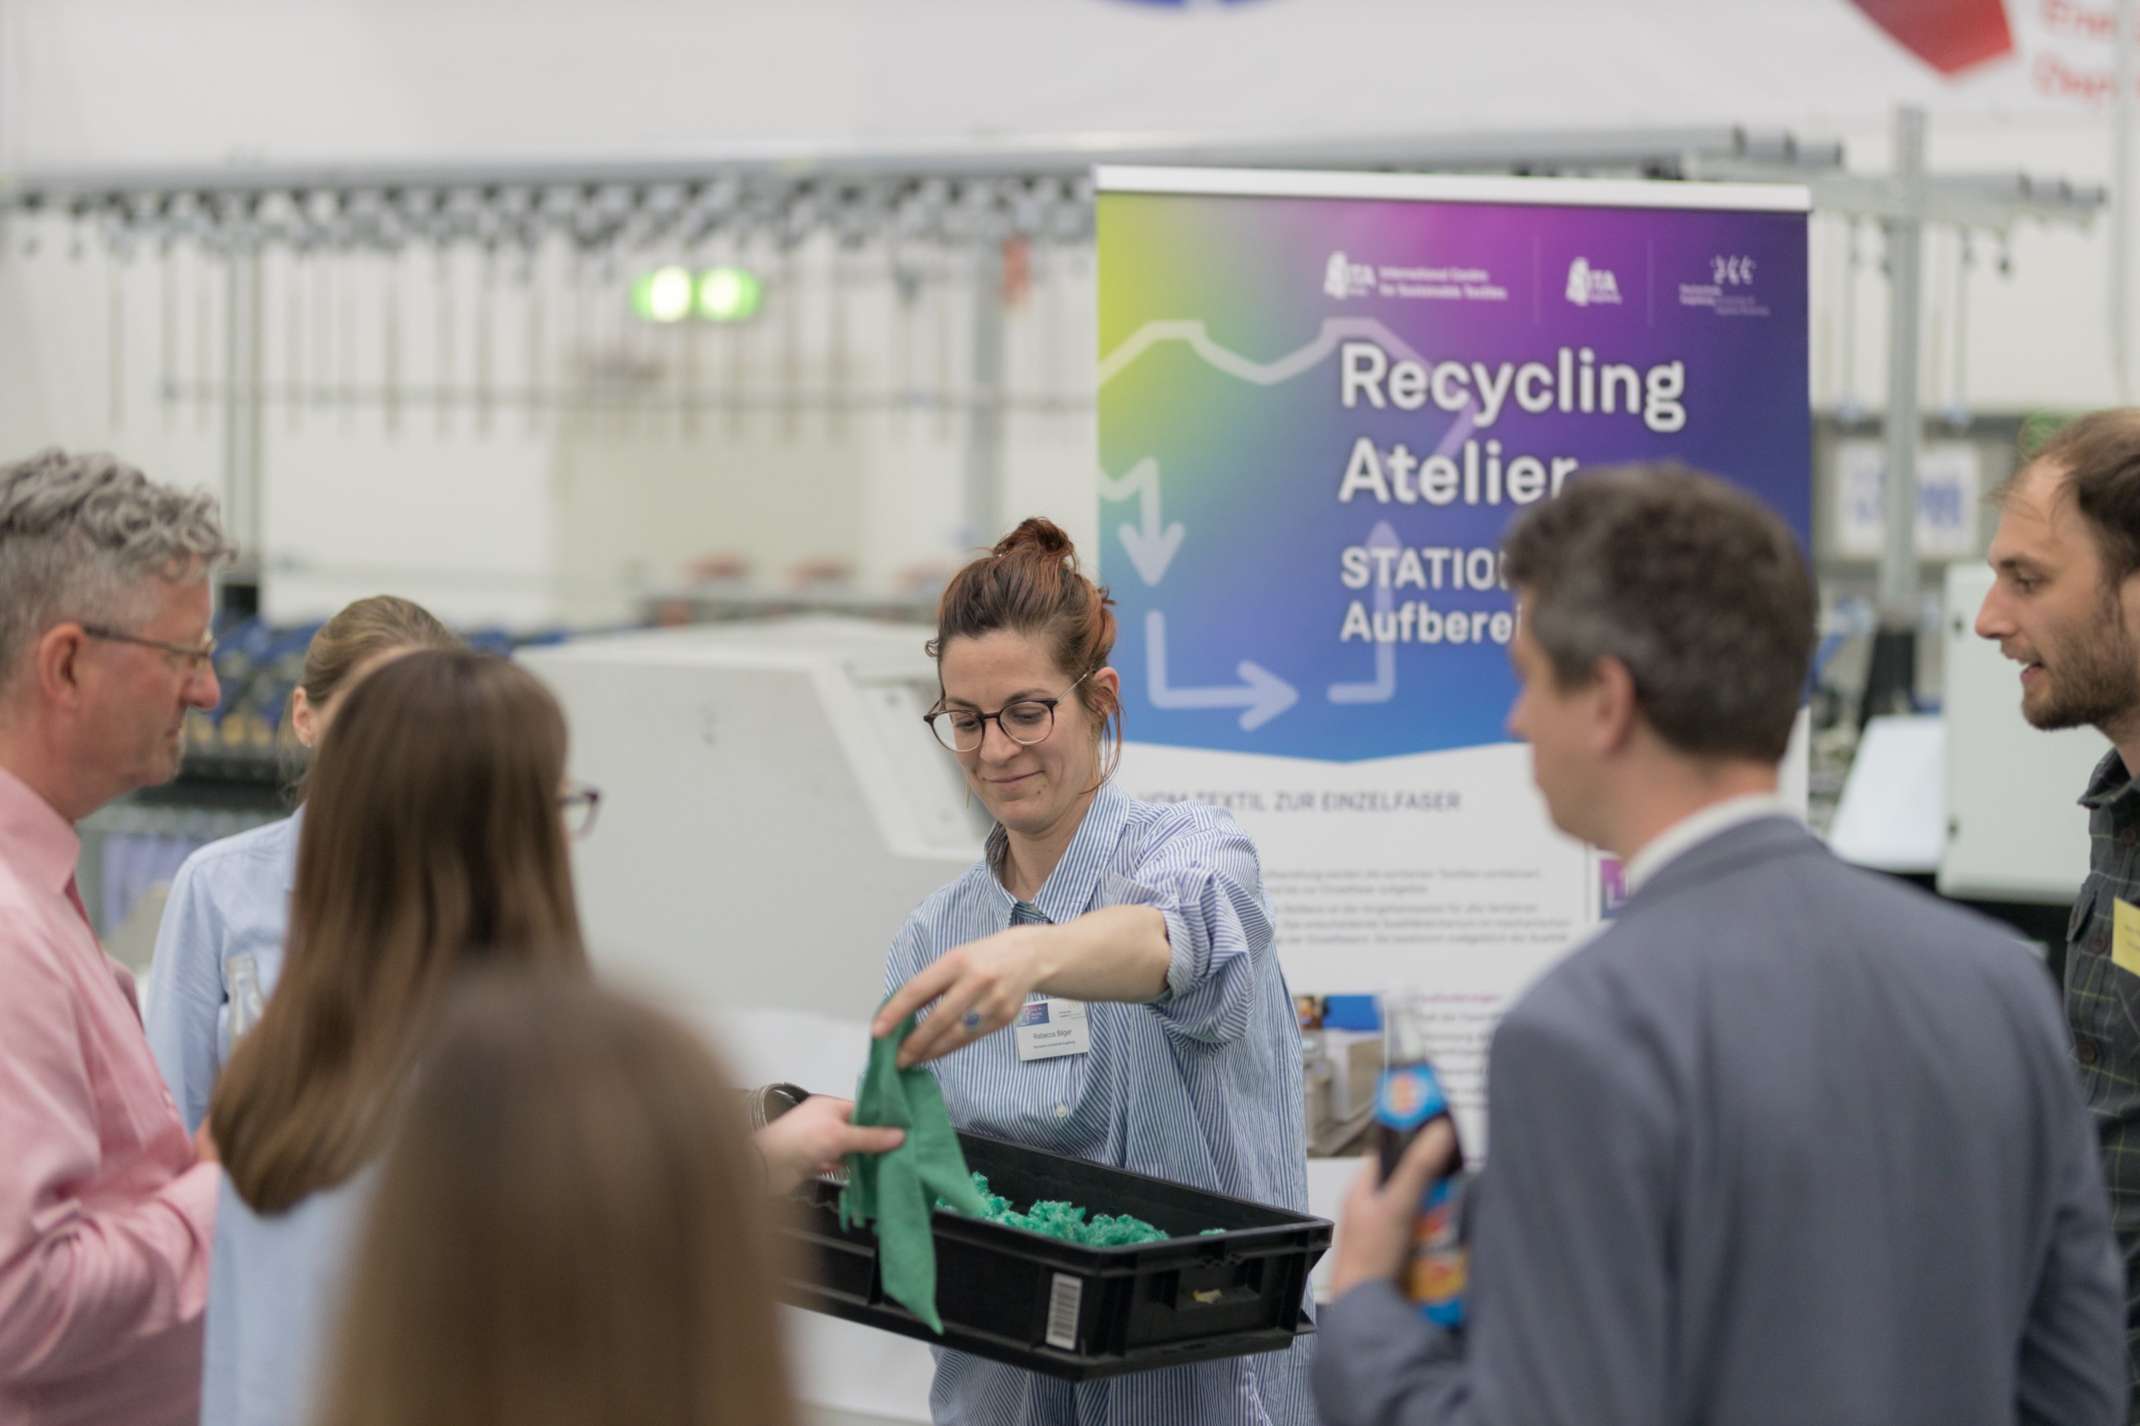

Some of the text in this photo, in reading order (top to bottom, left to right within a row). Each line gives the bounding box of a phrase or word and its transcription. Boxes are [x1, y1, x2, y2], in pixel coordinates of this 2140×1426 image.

[1340, 342, 1686, 432] Recycling
[1338, 436, 1578, 504] Atelier
[1341, 546, 1509, 591] STATIO
[1274, 791, 1314, 811] ZUR
[1321, 791, 1462, 812] EINZELFASER
